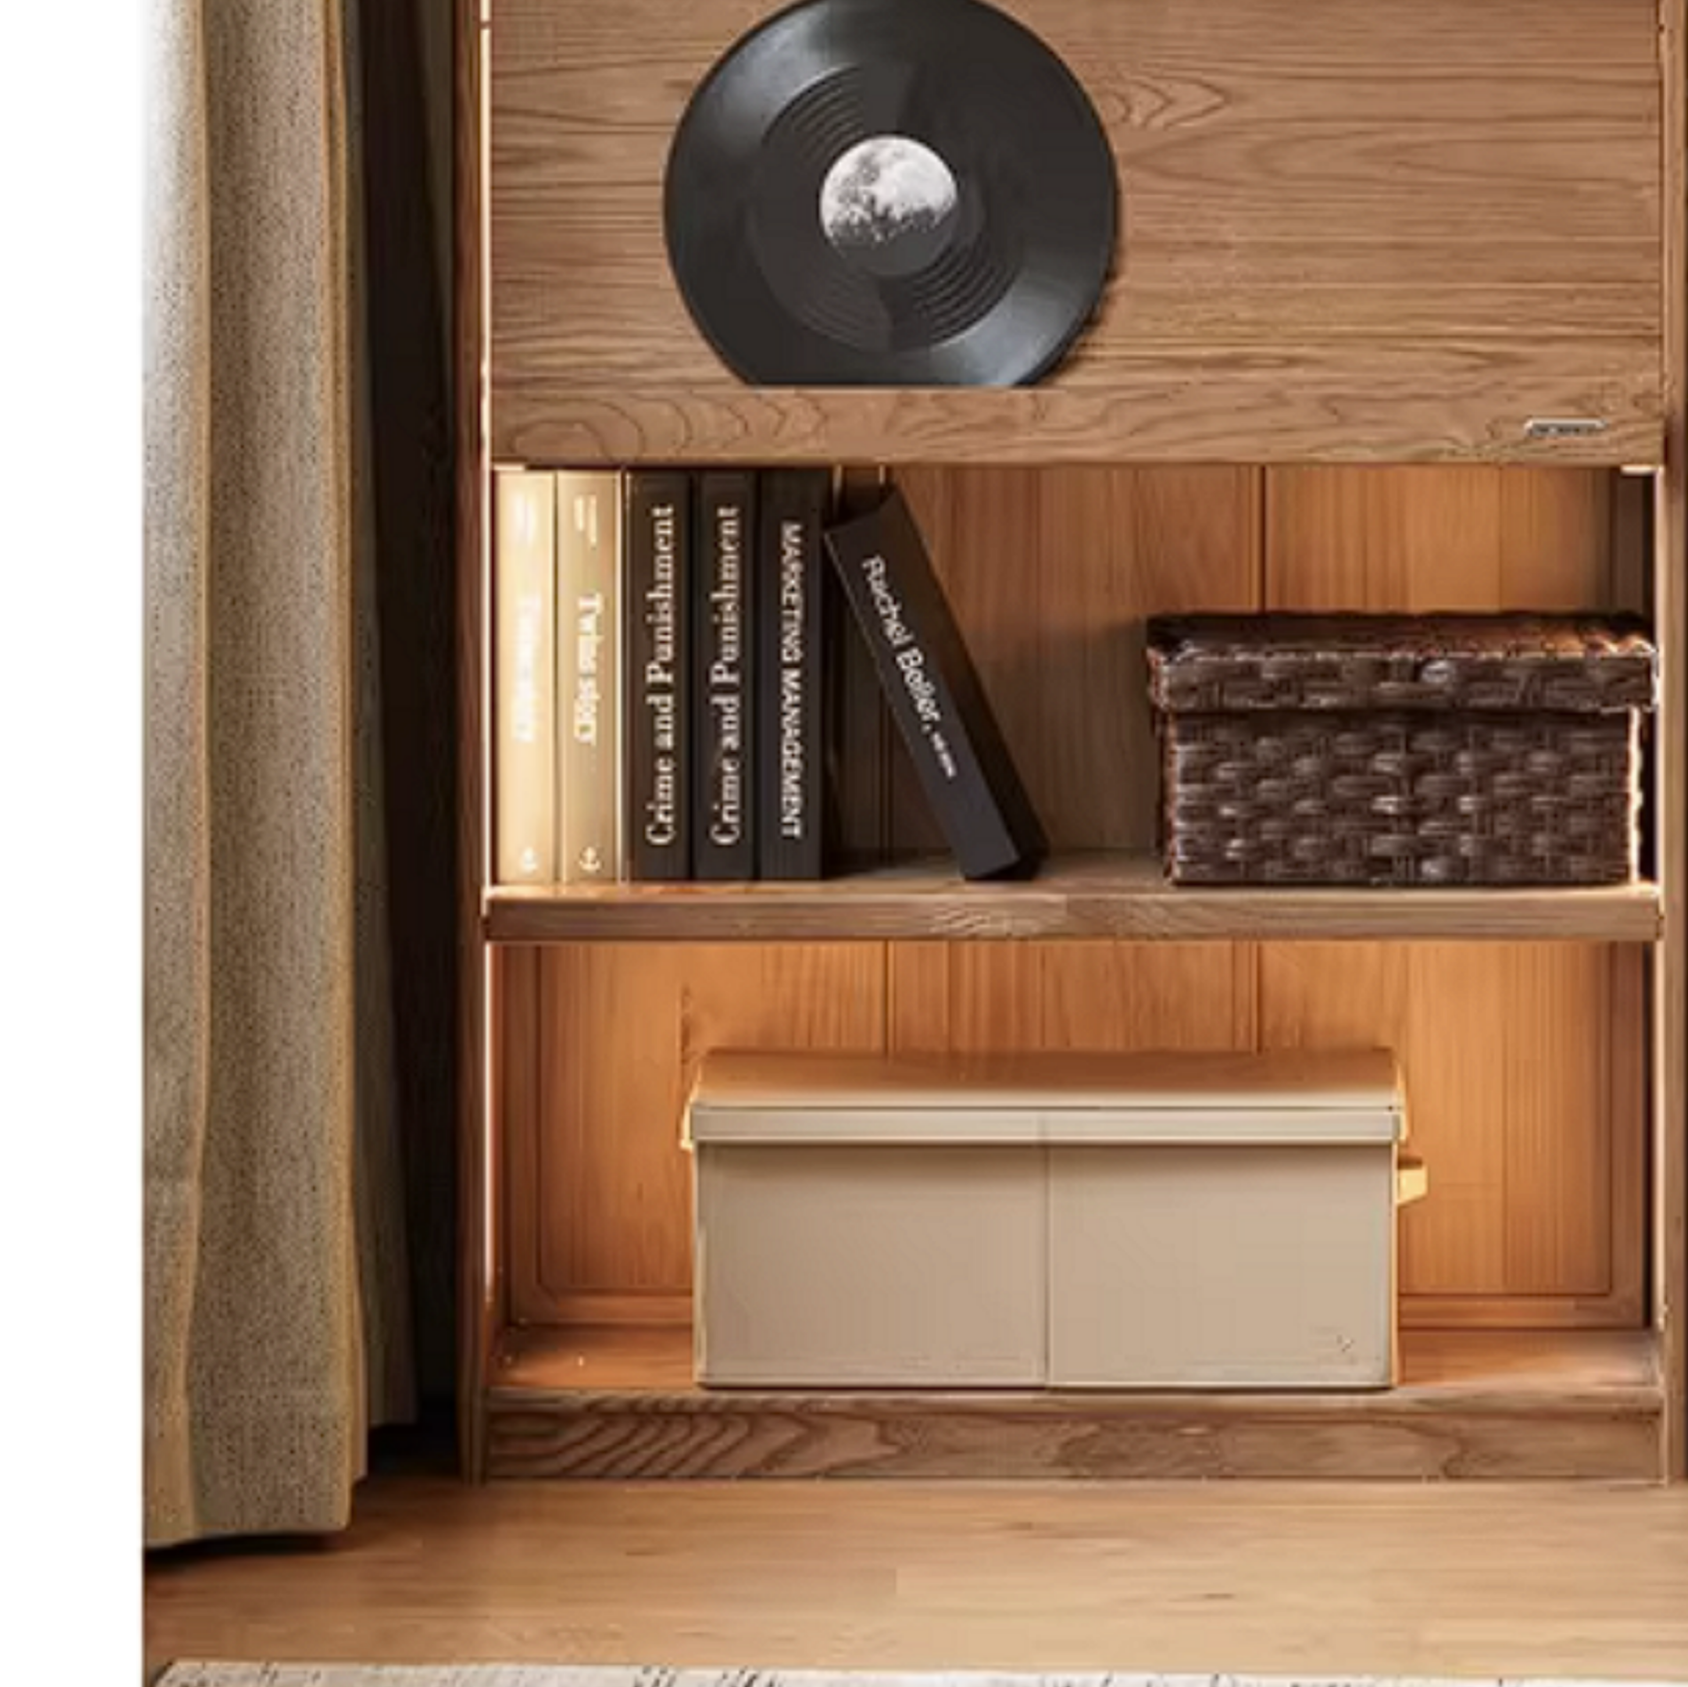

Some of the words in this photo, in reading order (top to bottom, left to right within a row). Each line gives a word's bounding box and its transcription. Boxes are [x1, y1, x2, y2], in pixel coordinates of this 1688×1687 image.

[645, 506, 674, 685] Punishment
[709, 506, 740, 685] Punishment
[780, 521, 802, 662] MARKETING
[861, 554, 915, 646] Rachel
[645, 693, 674, 750] and
[711, 693, 740, 750] and
[780, 668, 802, 839] MANAGEMENT
[645, 757, 675, 846] Crime
[711, 757, 740, 846] Crime
